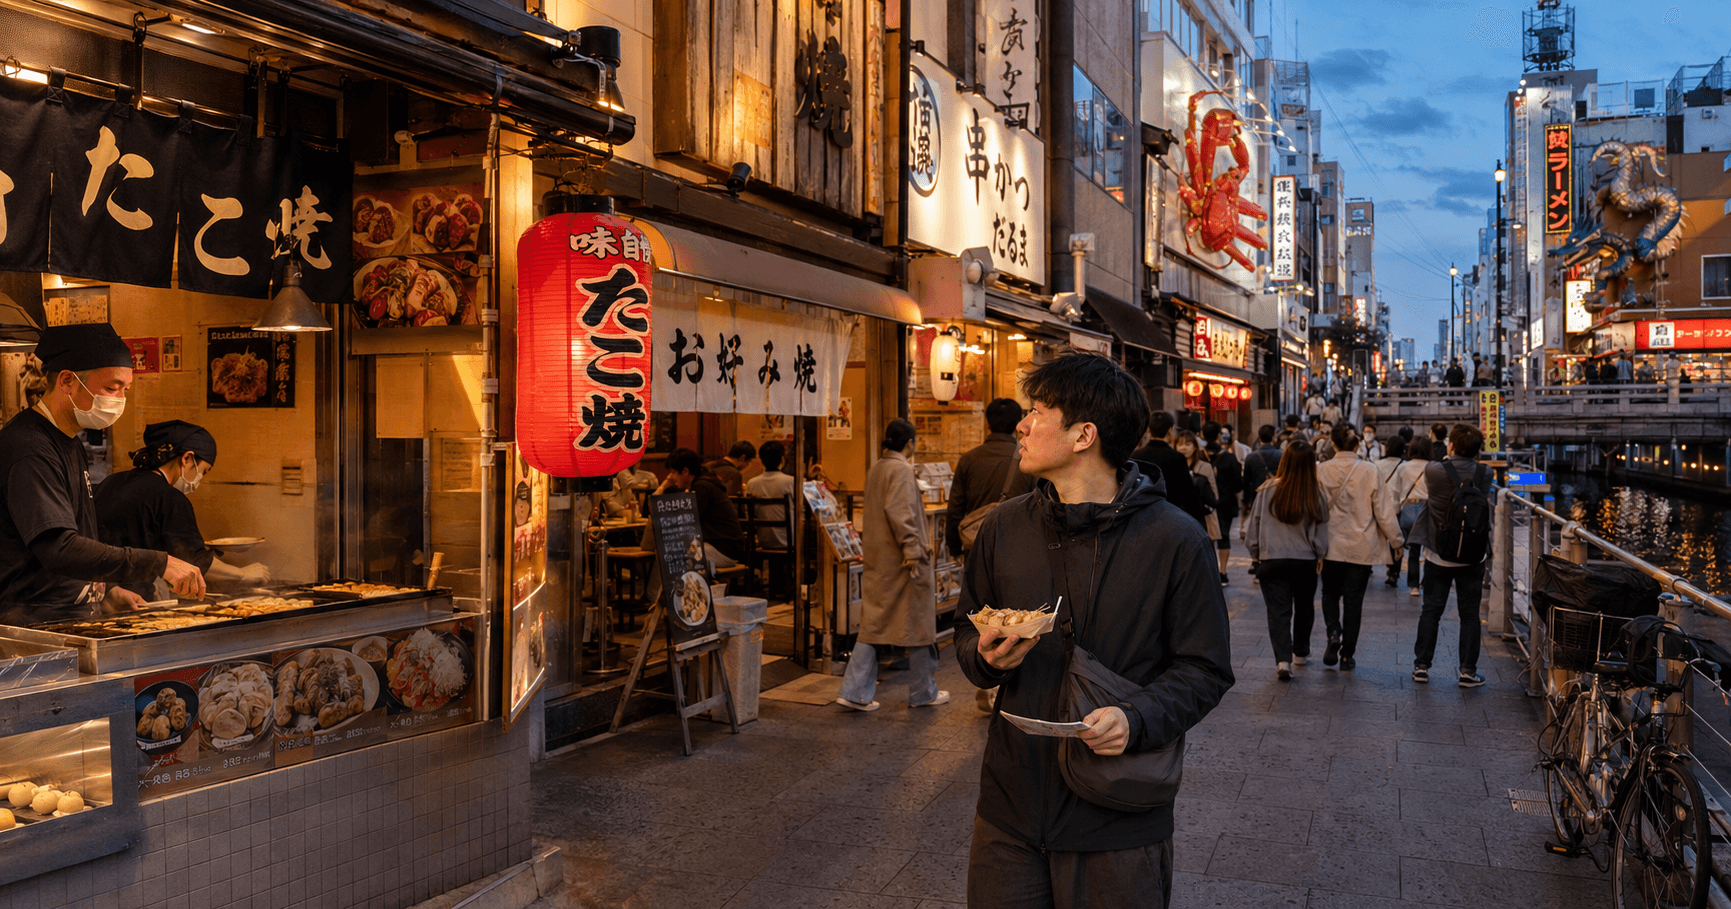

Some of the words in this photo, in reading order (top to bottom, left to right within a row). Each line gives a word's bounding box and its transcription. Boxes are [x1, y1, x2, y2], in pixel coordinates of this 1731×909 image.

[965, 107, 1030, 212] 串かつ
[992, 212, 1029, 268] だるま
[574, 265, 649, 453] たこ焼
[668, 328, 818, 394] お好み焼
